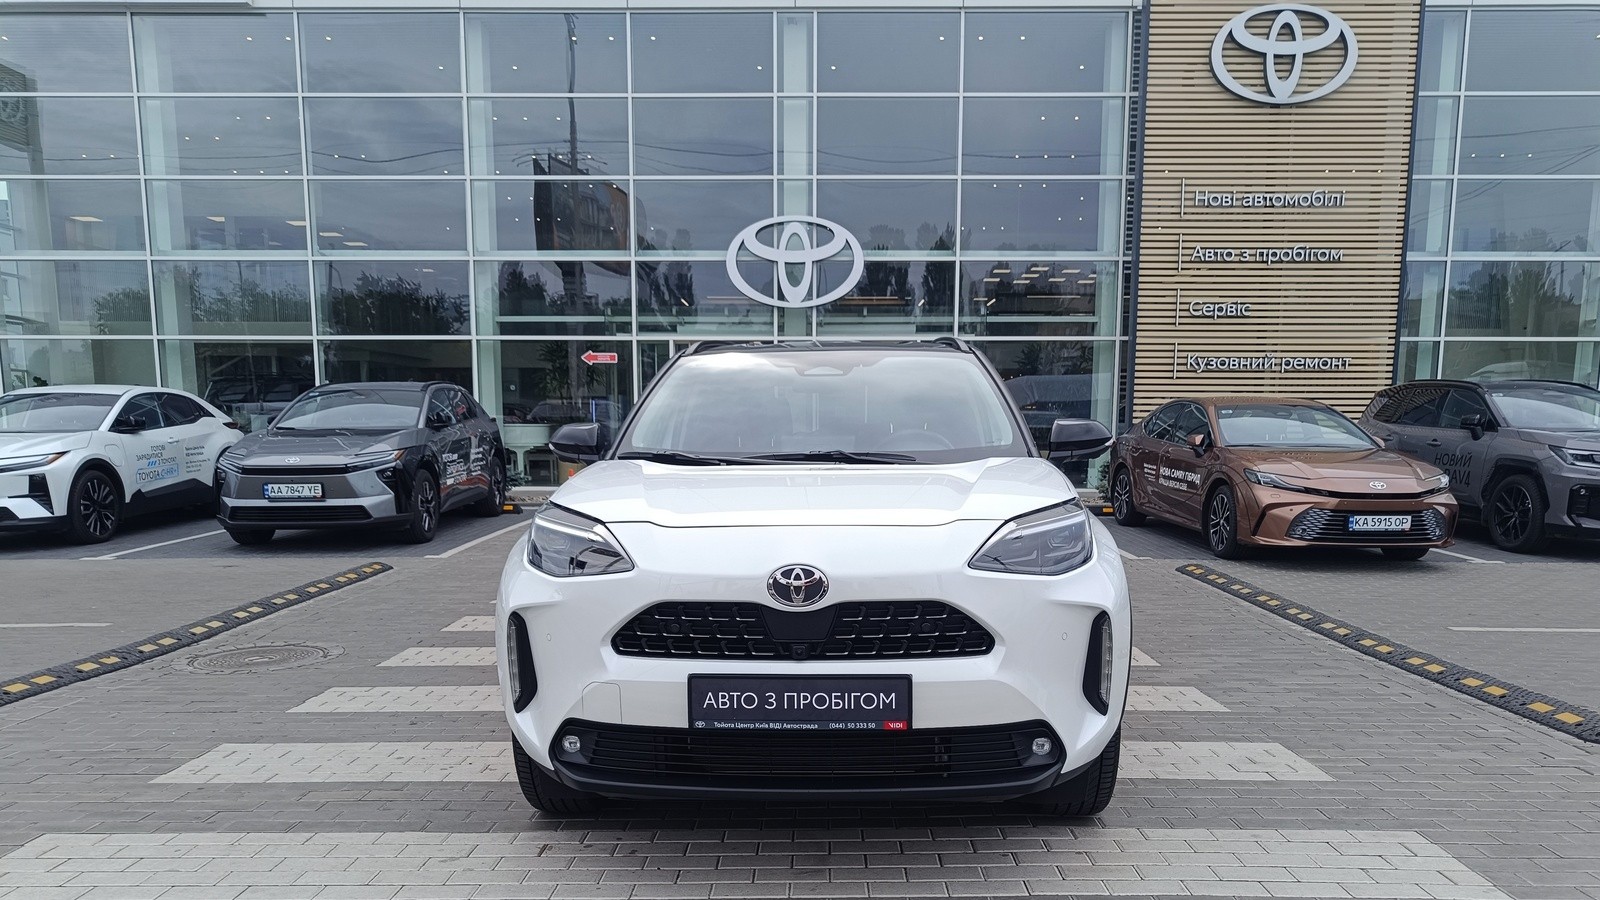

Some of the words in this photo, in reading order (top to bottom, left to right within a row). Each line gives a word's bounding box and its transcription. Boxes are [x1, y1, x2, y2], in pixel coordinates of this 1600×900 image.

[1194, 189, 1236, 207] Нові
[1242, 189, 1346, 207] автомобілі
[1190, 245, 1235, 262] Авто
[1239, 248, 1250, 262] з
[1256, 245, 1344, 266] пробігом
[1189, 300, 1252, 320] Сервіс
[1187, 353, 1275, 373] Кузовний
[1281, 357, 1352, 373] ремонт
[1434, 451, 1472, 468] НОВИЙ
[138, 469, 160, 481] TOYOTA
[270, 486, 283, 494] AA
[285, 486, 305, 494] 7847
[307, 486, 320, 494] YE
[1354, 517, 1369, 527] KA
[1371, 517, 1393, 527] 5915
[1394, 517, 1409, 527] OP
[703, 691, 758, 709] АВТО
[764, 692, 777, 709] З
[784, 692, 896, 710] ПРОБІГОМ
[713, 721, 735, 729] Тойота
[735, 722, 755, 730] Центр
[769, 722, 782, 730] ВІДІ
